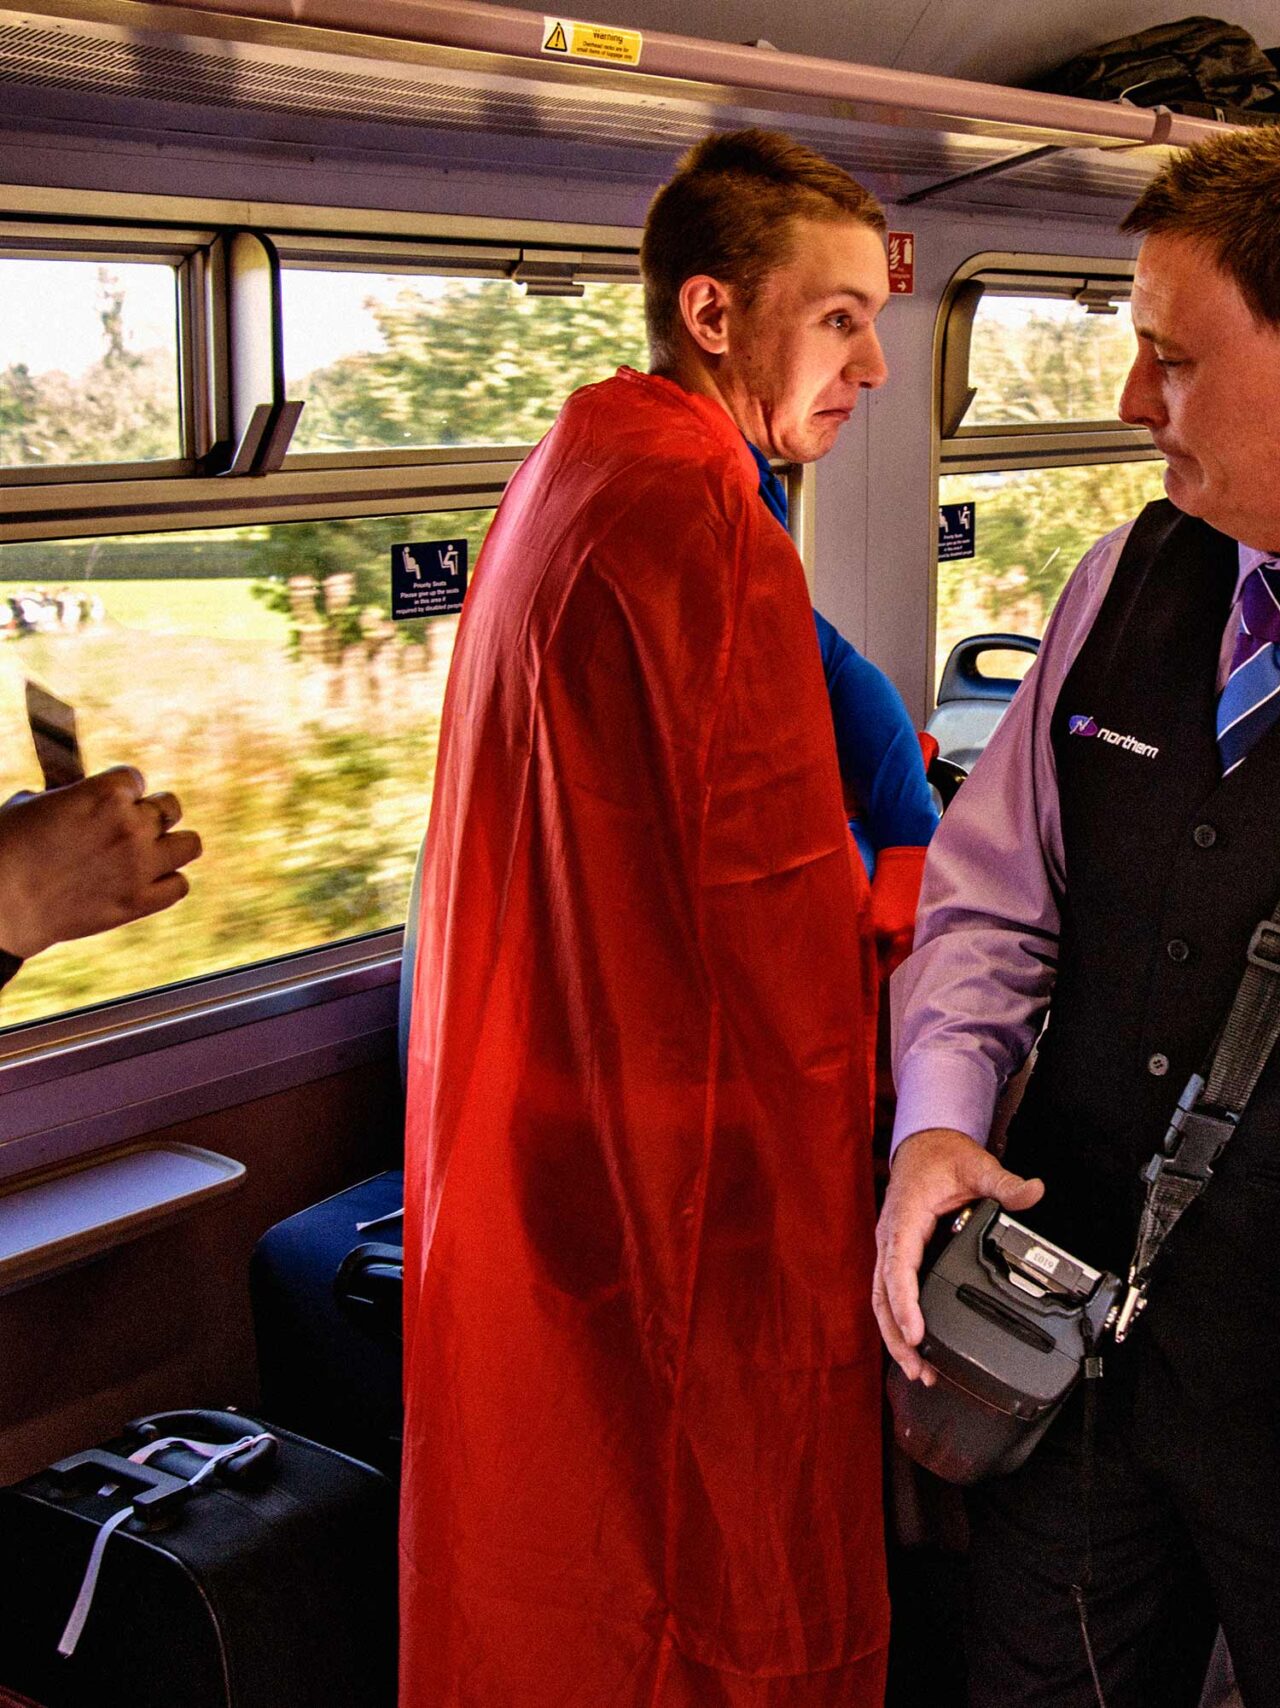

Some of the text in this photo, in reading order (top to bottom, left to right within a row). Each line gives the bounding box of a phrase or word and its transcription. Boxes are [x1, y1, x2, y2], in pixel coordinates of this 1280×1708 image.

[593, 32, 624, 45] Warning
[395, 607, 417, 615] required
[1096, 727, 1159, 760] northern
